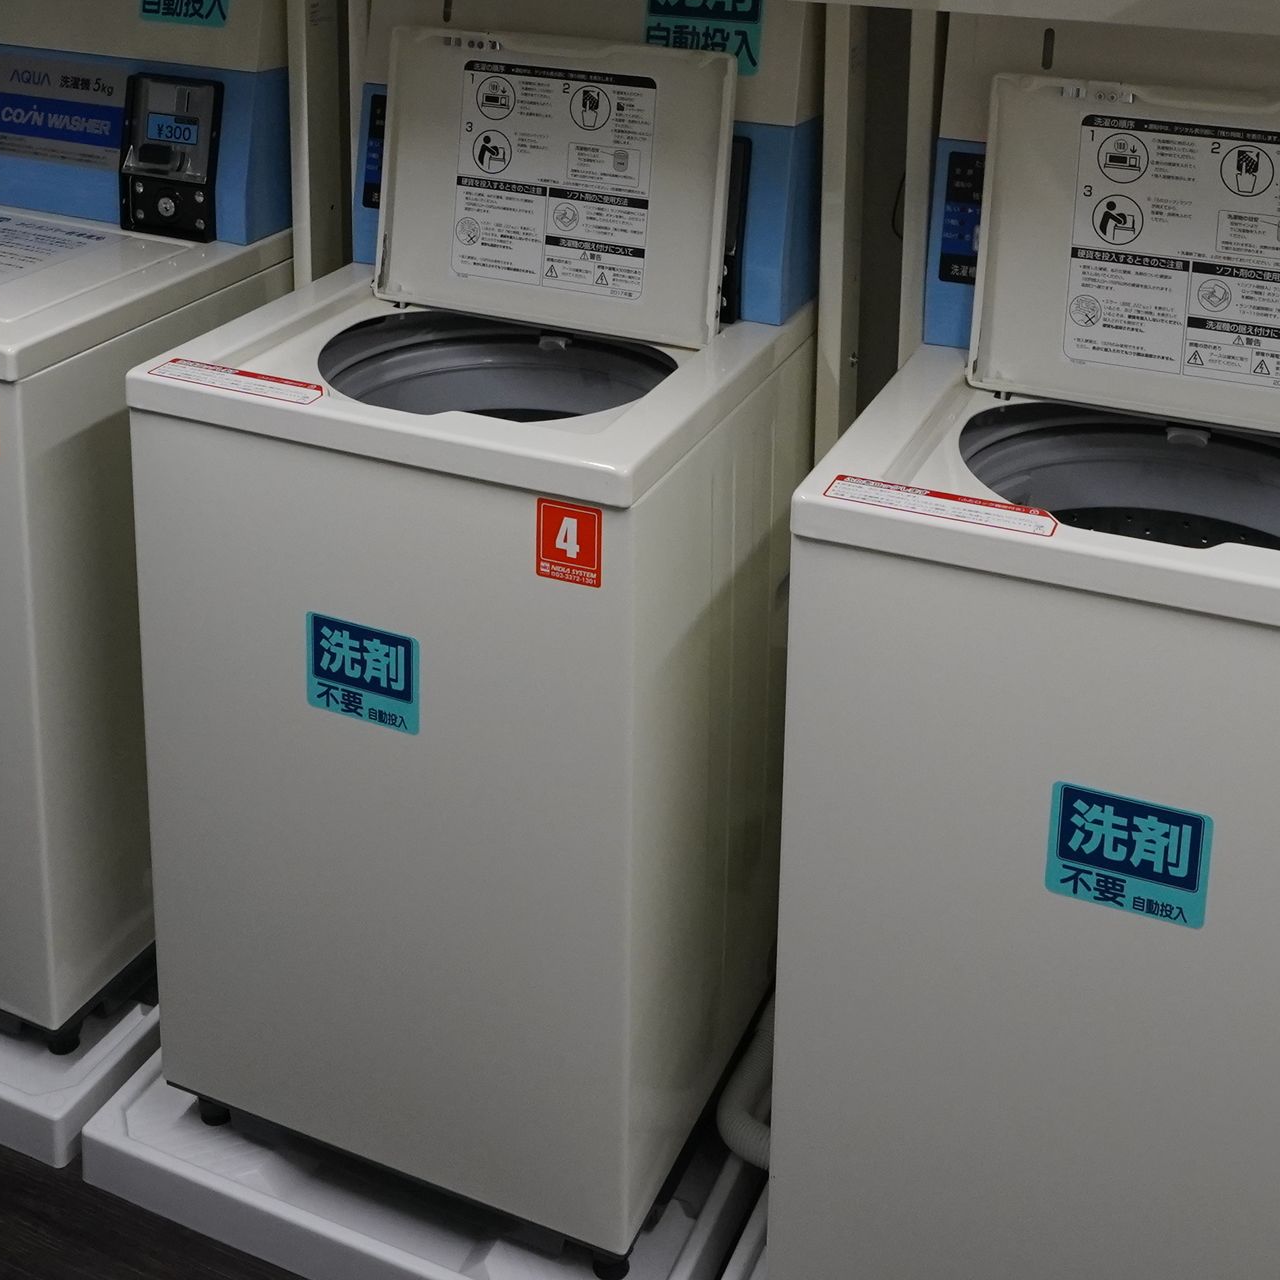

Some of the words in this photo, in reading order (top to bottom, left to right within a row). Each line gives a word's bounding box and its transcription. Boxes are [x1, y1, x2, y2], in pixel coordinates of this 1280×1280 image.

[10, 70, 51, 85] AQUA
[563, 83, 570, 94] 2
[48, 113, 111, 135] WASHER
[157, 123, 191, 140] ¥300
[466, 122, 473, 132] 3
[1211, 142, 1220, 154] 2
[1083, 185, 1093, 196] 3
[555, 517, 579, 558] 4
[320, 626, 404, 691] 洗剤
[317, 683, 363, 717] 不要
[369, 708, 408, 729] 自動投入
[1068, 799, 1191, 878] 洗剤
[1060, 864, 1126, 907] 不要
[1133, 896, 1188, 923] 自動投入
